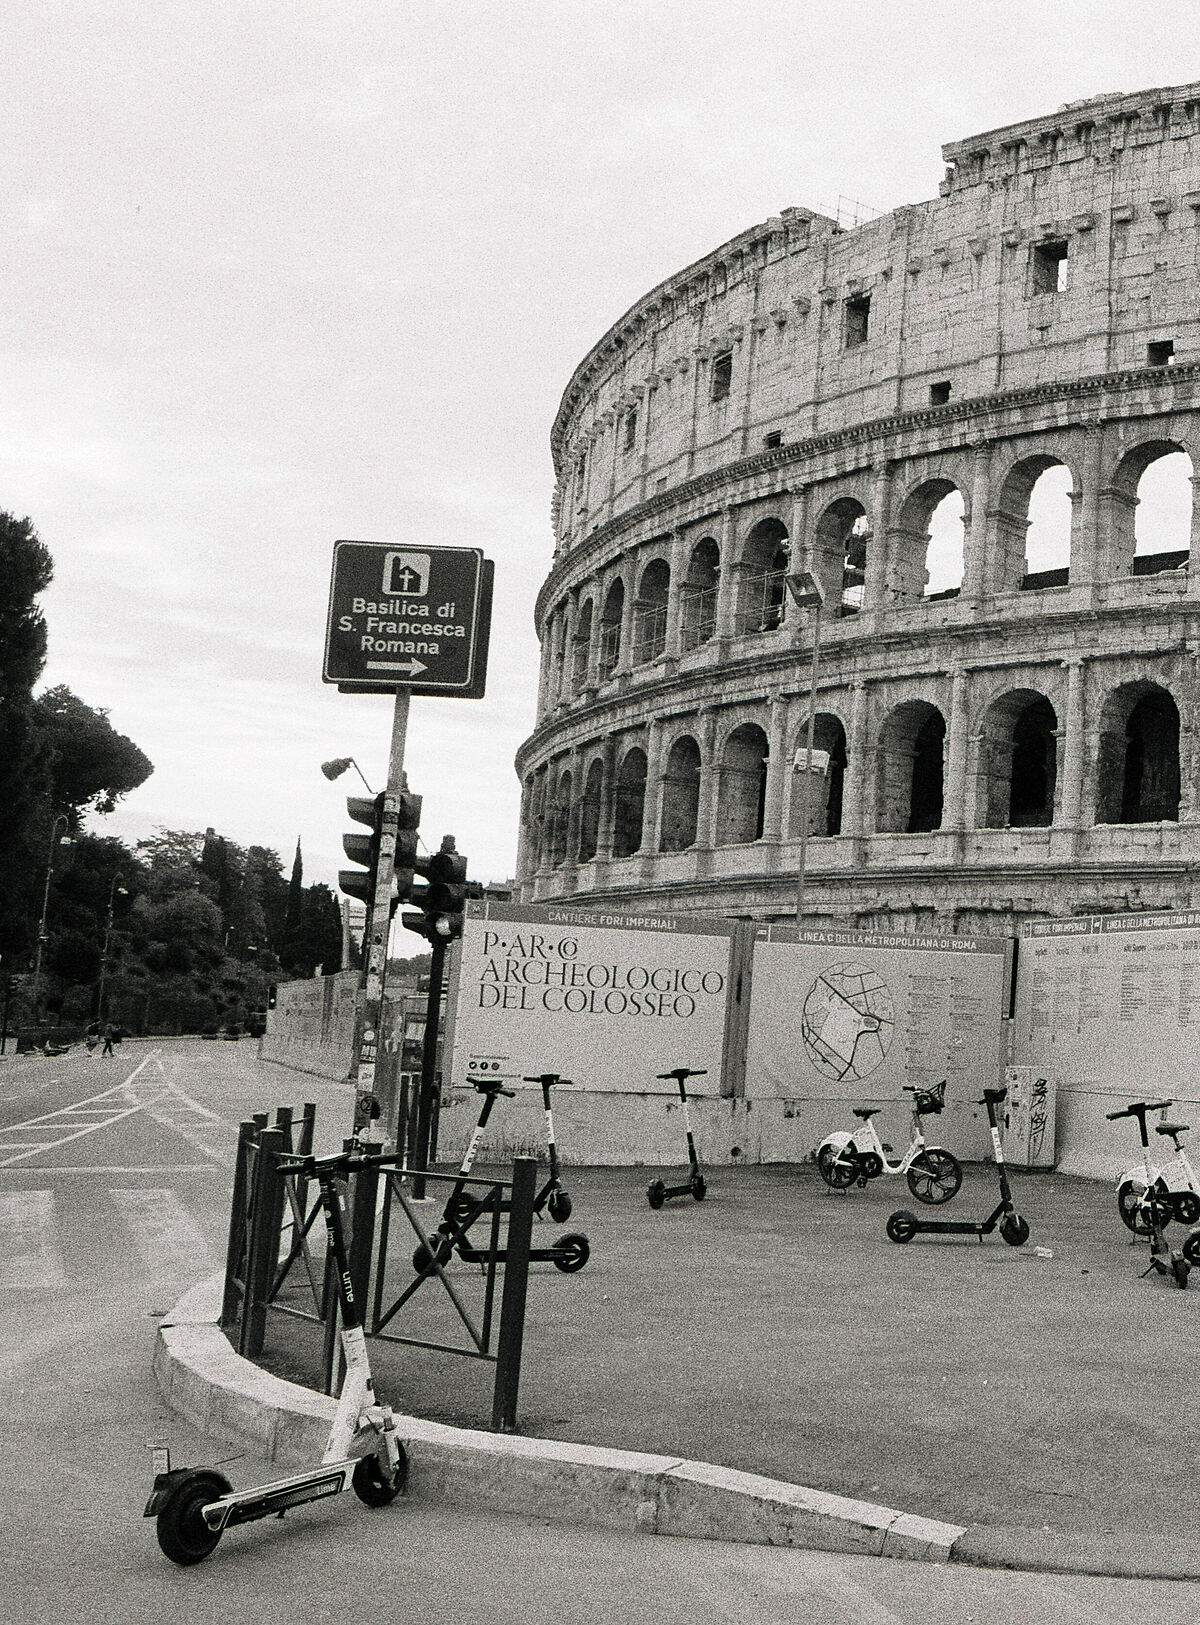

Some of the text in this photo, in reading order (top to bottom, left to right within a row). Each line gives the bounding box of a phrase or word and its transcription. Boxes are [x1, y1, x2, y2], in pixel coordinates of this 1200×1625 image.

[352, 598, 456, 618] Basilica di
[338, 615, 466, 638] S. Francesca
[361, 635, 440, 656] Romana
[548, 911, 676, 930] CANTIERE FORI IMPERIALI
[798, 931, 977, 950] LINEA C DELLA METROPOLITANA DI ROMA
[479, 959, 724, 995] ARCHEOLOGICO
[479, 983, 696, 1018] DEL COLOSSEO
